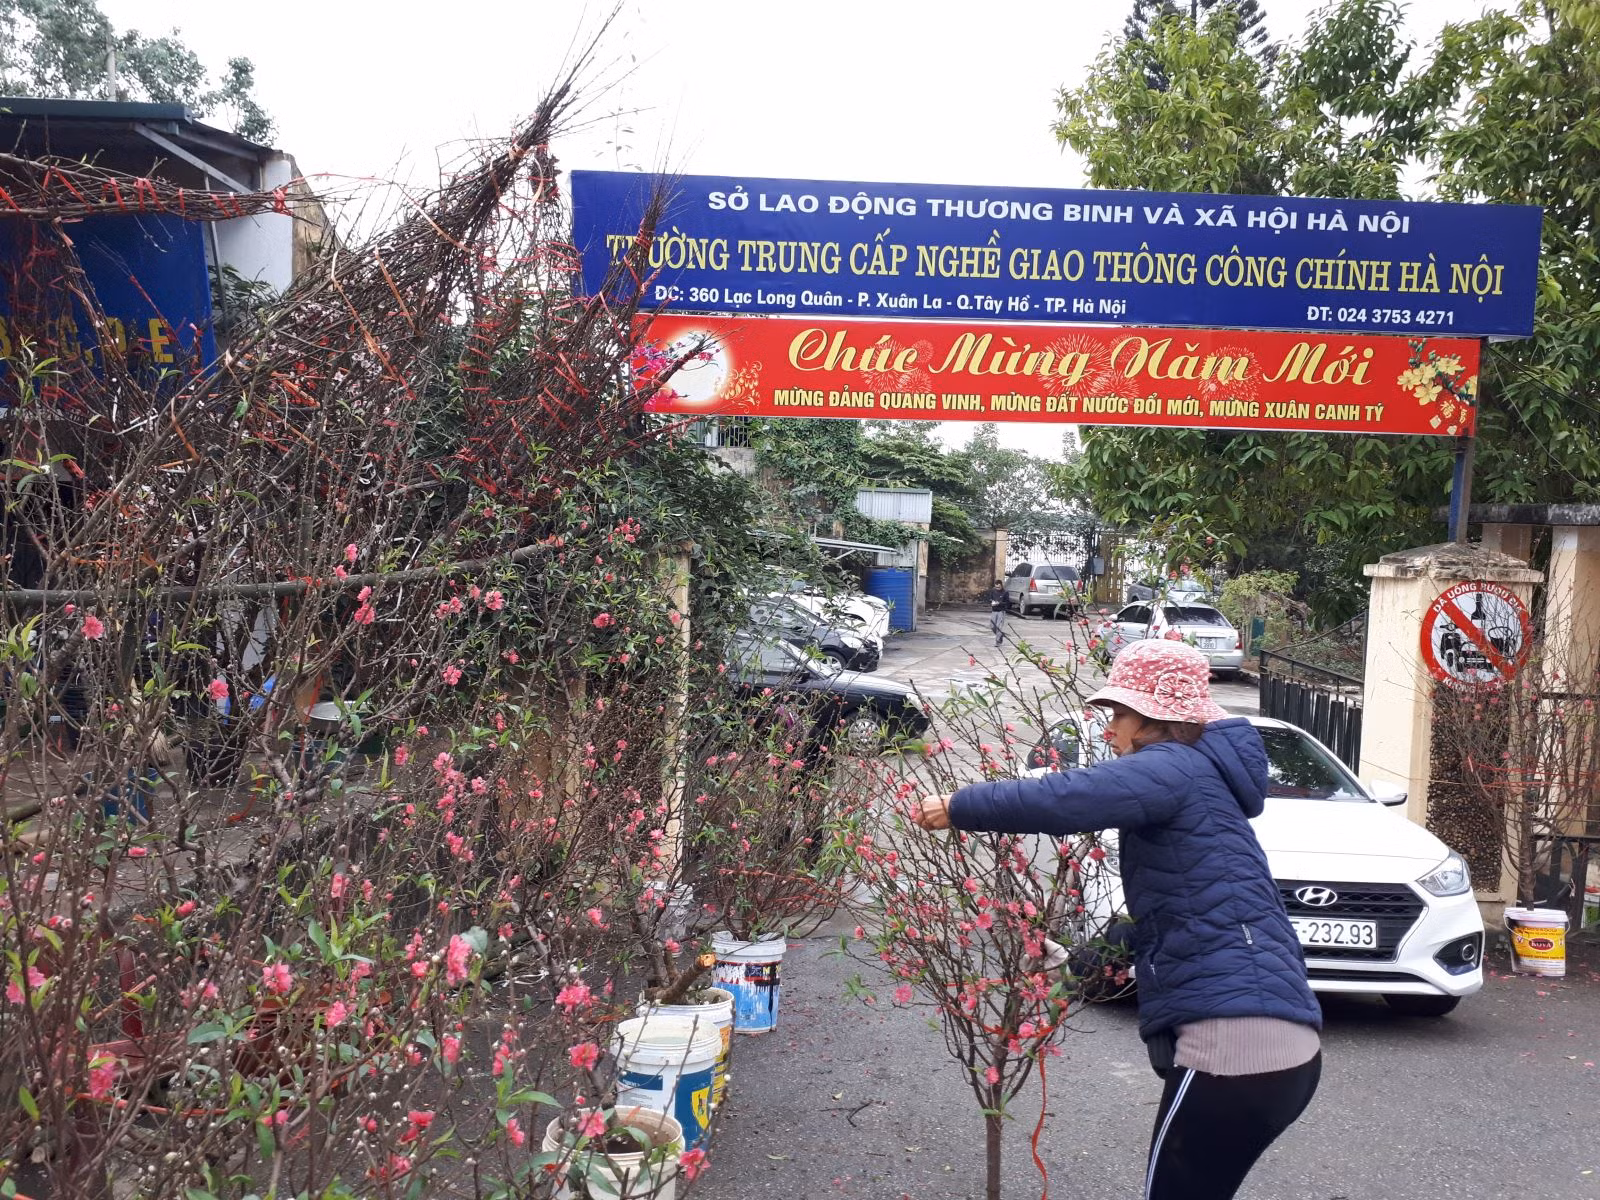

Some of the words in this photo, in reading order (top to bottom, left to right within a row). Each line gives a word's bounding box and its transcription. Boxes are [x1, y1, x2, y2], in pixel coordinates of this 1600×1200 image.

[708, 185, 749, 211] SỞ
[759, 193, 819, 213] LAO
[828, 191, 917, 220] ĐỘNG
[926, 198, 1053, 221] THƯƠNG
[1063, 203, 1133, 224] BINH
[1143, 202, 1185, 225] VÀ
[1193, 204, 1238, 228] XÃ
[1247, 206, 1298, 235] HỘI
[1307, 208, 1349, 232] HÀ
[1358, 210, 1410, 239] NỘI
[737, 239, 842, 274] TRUNG
[849, 227, 908, 276] CẤP
[914, 229, 1001, 278] NGHỀ
[1008, 248, 1085, 282] GIAO
[1093, 241, 1198, 285] THÔNG
[1205, 244, 1288, 288] CÔNG
[1295, 248, 1392, 291] CHÍNH
[1397, 252, 1441, 293] HÀ
[1448, 253, 1505, 304] NỘI
[655, 285, 684, 301] ĐC:
[689, 287, 720, 303] 360
[724, 288, 752, 308] Lạc
[757, 289, 796, 308] Long
[801, 290, 843, 307] Quân
[857, 292, 871, 307] P.
[876, 293, 918, 309] Xuân
[923, 294, 942, 309] La
[956, 294, 1003, 314] Q.Tây
[1008, 295, 1030, 312] Hồ
[1044, 298, 1067, 313] TP.
[1072, 298, 1094, 314] Hà
[1099, 299, 1126, 318] Nội
[1307, 306, 1333, 322] ĐT:
[1337, 307, 1367, 323] 024
[1372, 309, 1411, 324] 3753
[1416, 311, 1454, 325] 4271
[788, 328, 919, 373] Chúc
[928, 332, 1097, 387] Mừng
[1110, 336, 1252, 385] Năm
[1262, 342, 1374, 386] Mới
[774, 386, 825, 406] MỪNG
[829, 385, 875, 408] ĐẢNG
[879, 393, 937, 410] QUANG
[942, 393, 985, 413] VINH,
[990, 392, 1041, 413] MỪNG
[1046, 391, 1079, 413] ĐẤT
[1082, 392, 1129, 414] NƯỚC
[1133, 393, 1162, 415] ĐỔI
[1166, 395, 1204, 418] MỚI,
[1209, 397, 1260, 418] MỪNG
[1264, 399, 1310, 419] XUÂN
[1315, 403, 1361, 421] CANH
[1365, 402, 1385, 422] TÝ
